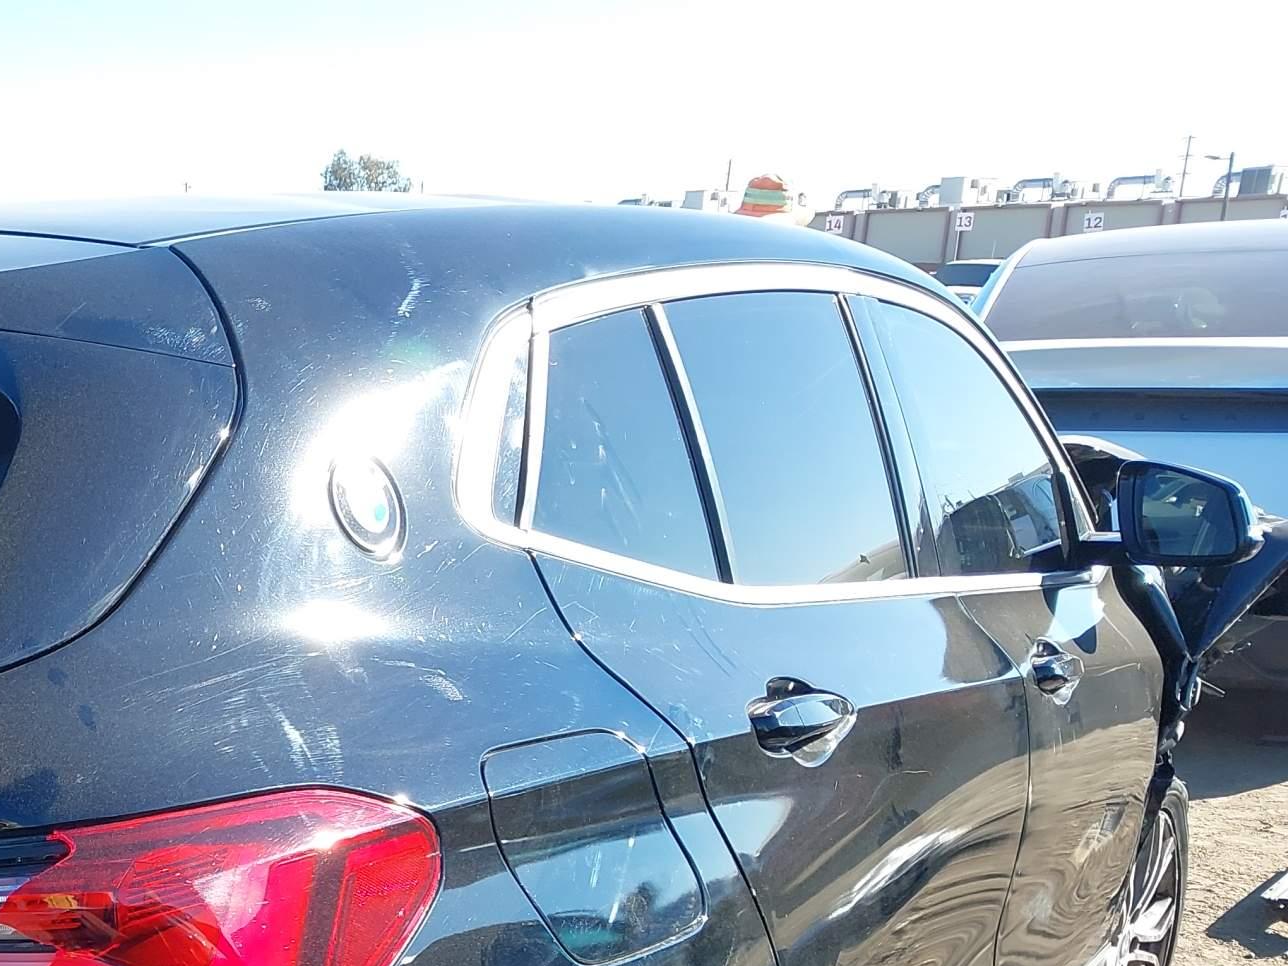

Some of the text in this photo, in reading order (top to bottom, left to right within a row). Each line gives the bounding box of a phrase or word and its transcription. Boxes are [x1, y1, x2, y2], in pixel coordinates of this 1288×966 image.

[826, 218, 842, 231] 14
[956, 215, 973, 228] 13
[1085, 216, 1103, 229] 12
